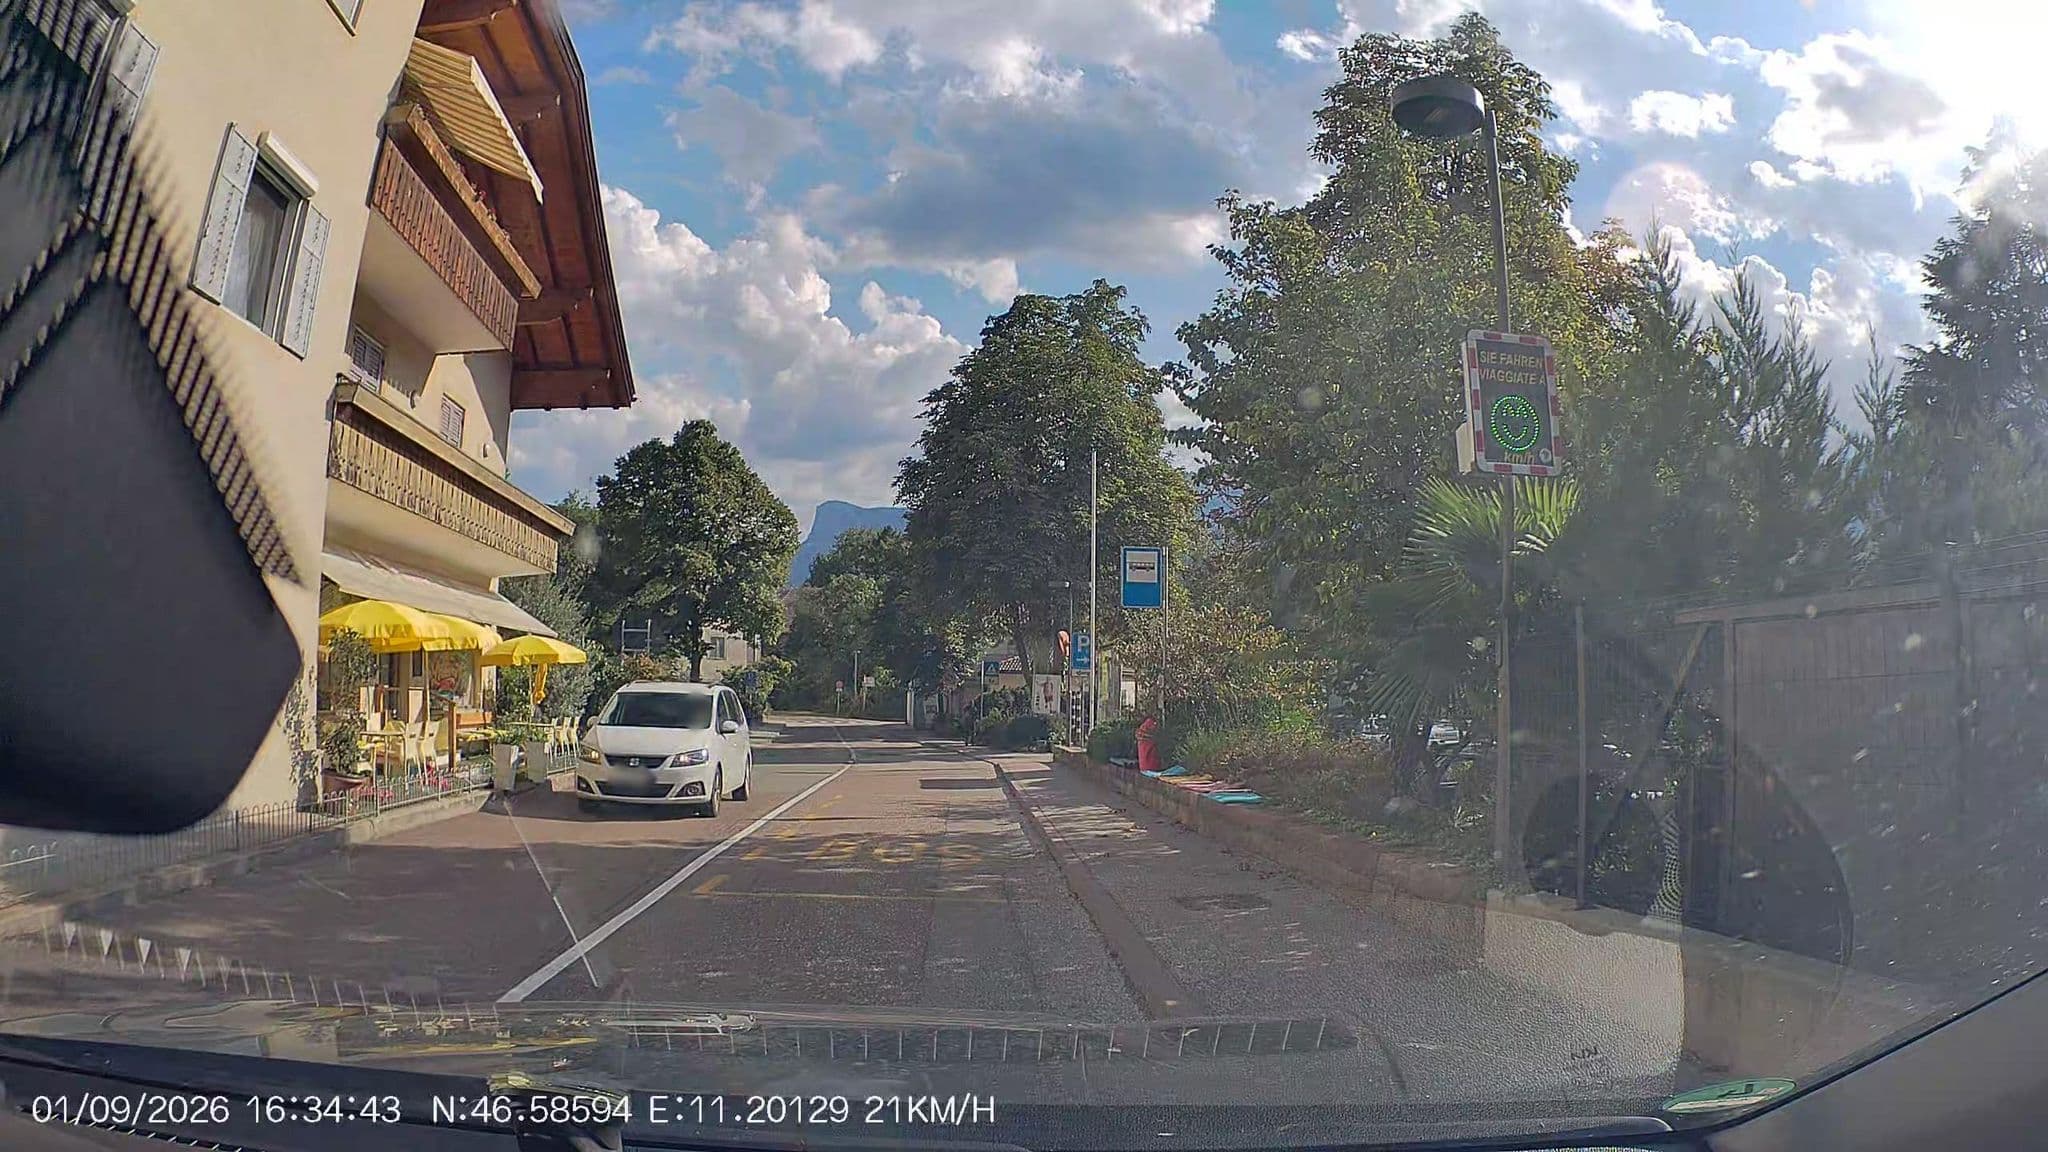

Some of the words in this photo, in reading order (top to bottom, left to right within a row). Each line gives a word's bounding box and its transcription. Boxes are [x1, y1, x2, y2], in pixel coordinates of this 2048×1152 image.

[1480, 350, 1497, 364] SIE
[1499, 353, 1544, 369] FAHREN
[1479, 368, 1537, 385] VIAGGIATE
[1078, 635, 1090, 653] P
